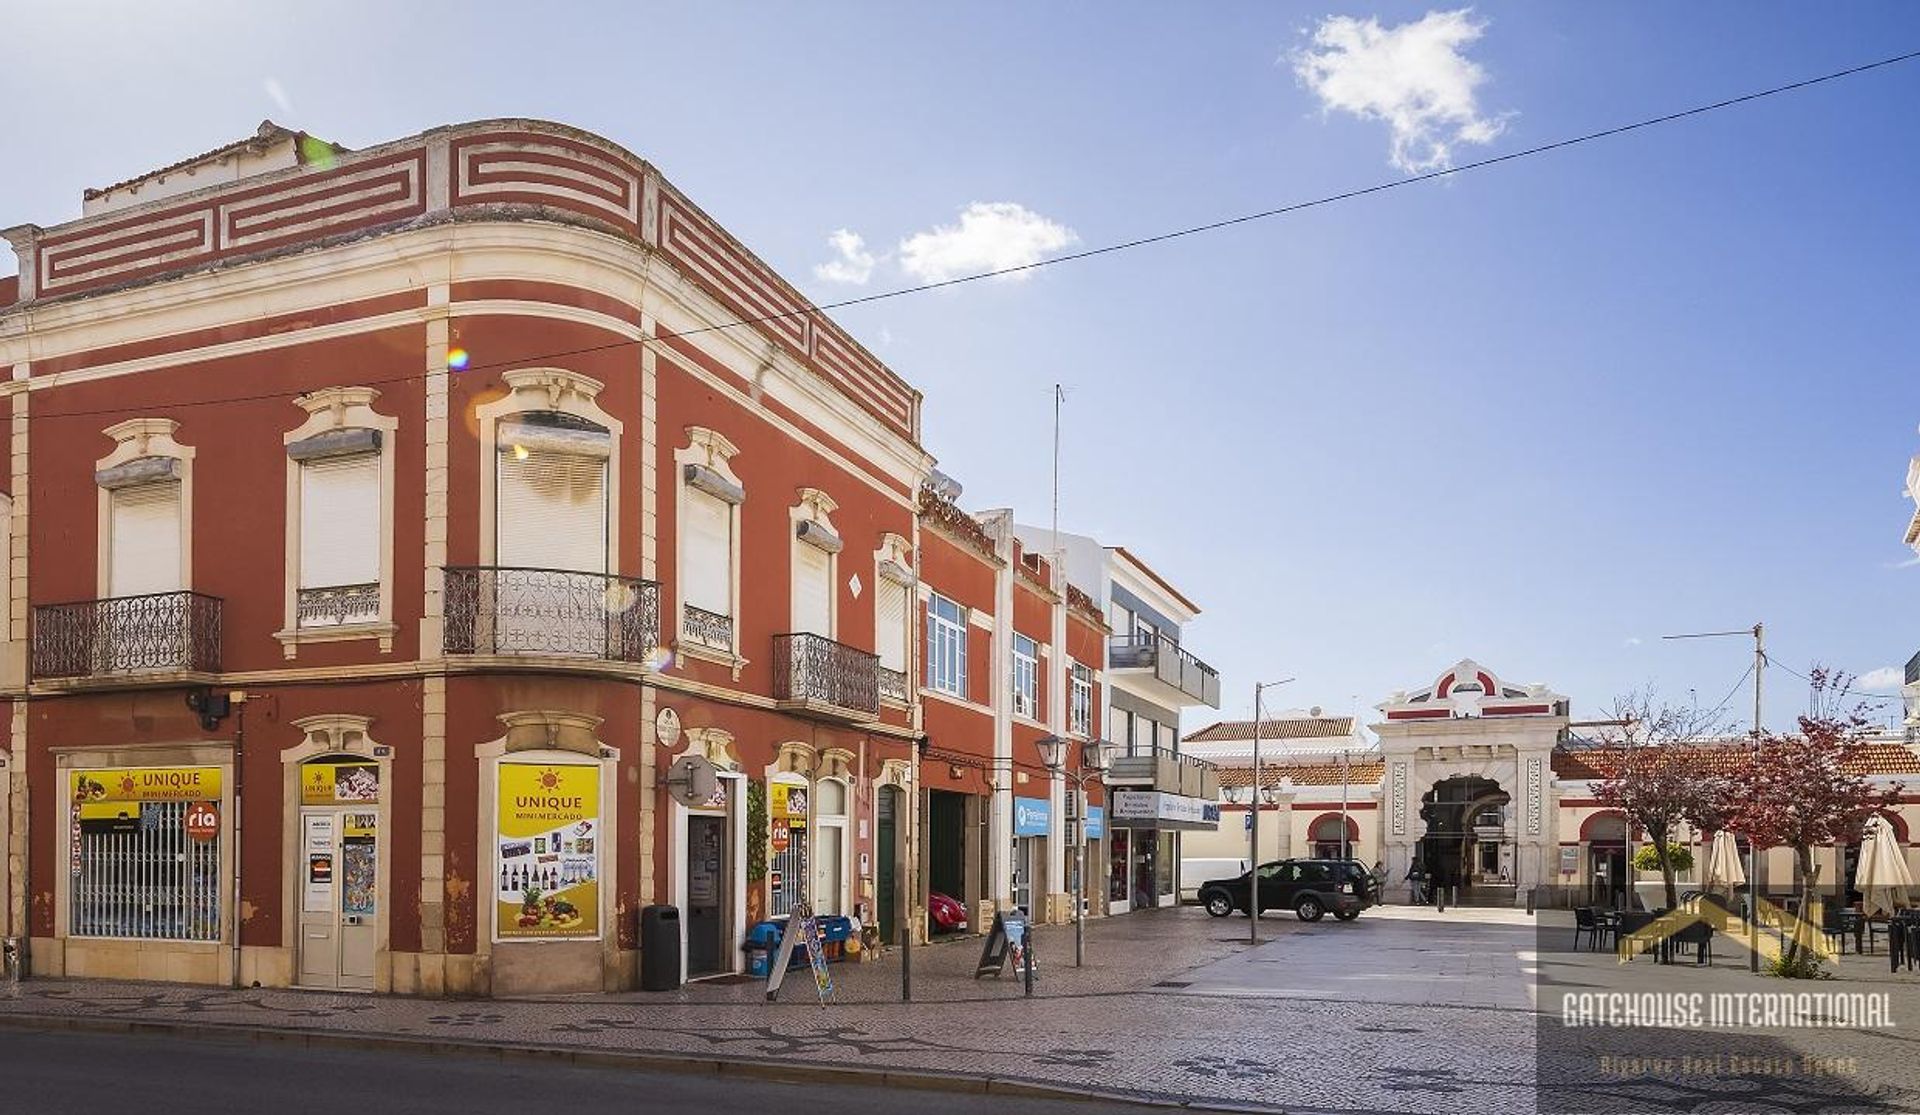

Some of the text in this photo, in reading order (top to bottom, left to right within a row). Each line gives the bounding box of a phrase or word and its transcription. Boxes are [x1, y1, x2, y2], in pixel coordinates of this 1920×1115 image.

[143, 773, 200, 789] UNIQUE
[516, 796, 582, 811] UNIQUE
[188, 807, 216, 827] ria
[515, 812, 583, 820] MINIMERCADO
[773, 822, 788, 839] ria
